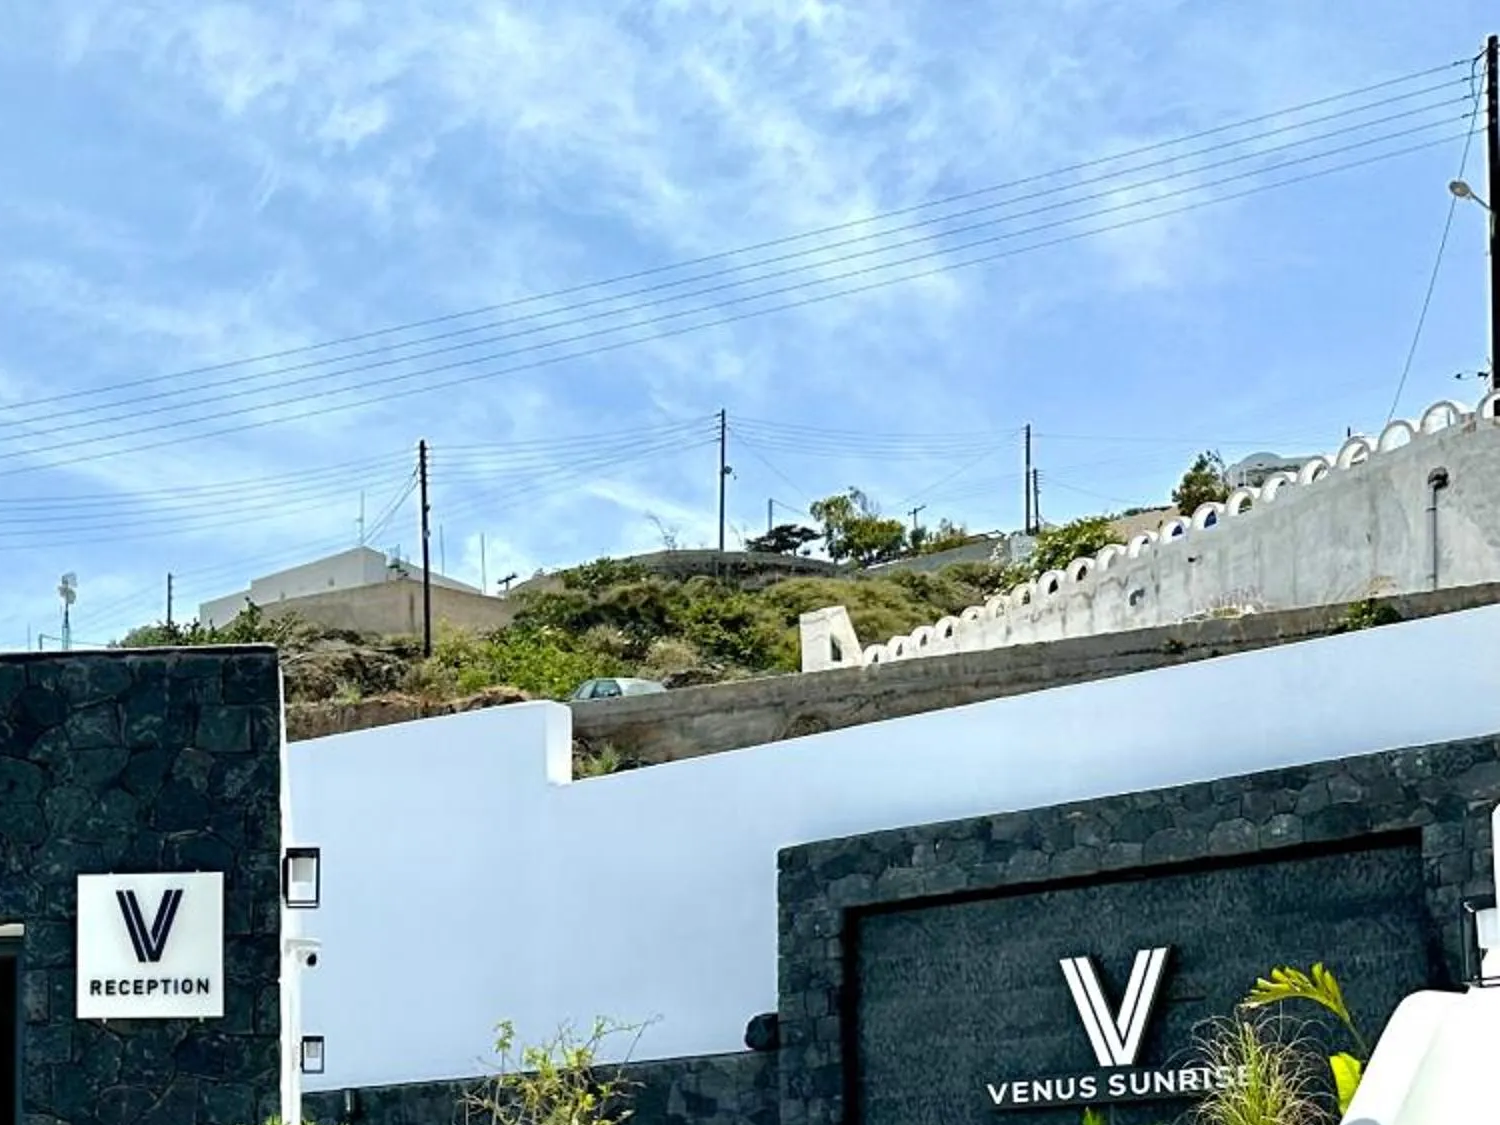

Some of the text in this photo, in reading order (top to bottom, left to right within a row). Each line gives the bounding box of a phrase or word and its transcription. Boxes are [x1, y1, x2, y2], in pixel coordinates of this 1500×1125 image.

[115, 889, 184, 963] V
[89, 978, 211, 997] RECEPTION
[1059, 947, 1169, 1067] V
[986, 1075, 1098, 1105] VENUS
